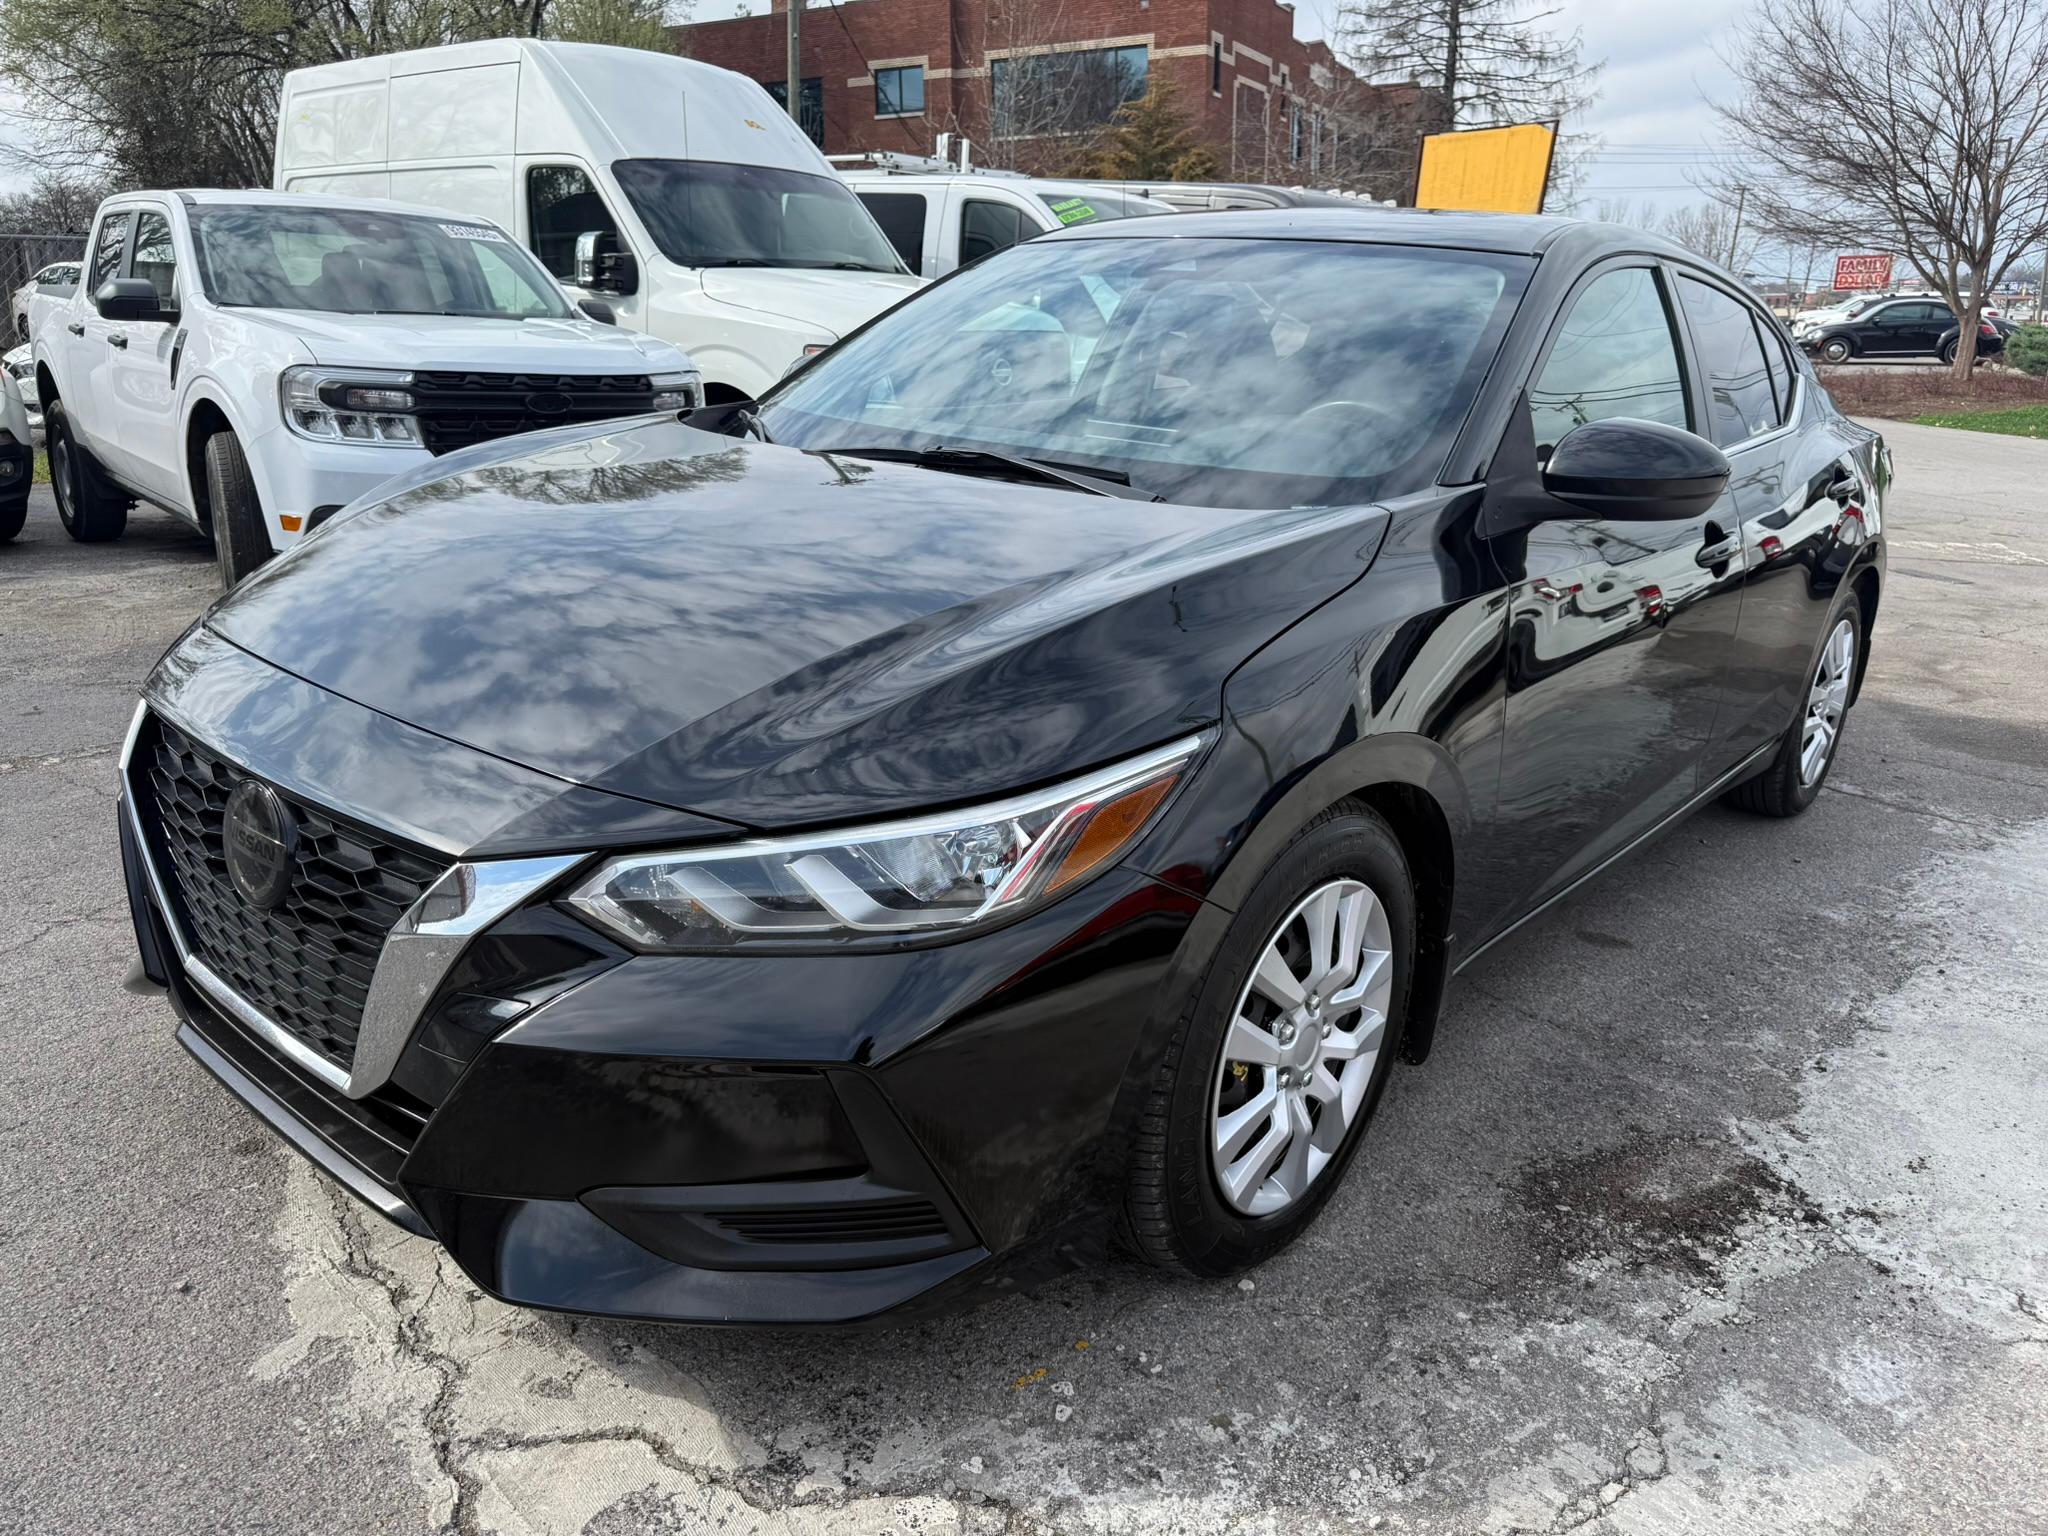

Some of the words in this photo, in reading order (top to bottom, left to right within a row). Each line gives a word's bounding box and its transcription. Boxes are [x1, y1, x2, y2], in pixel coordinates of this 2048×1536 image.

[1839, 257, 1888, 273] FAMILY
[1837, 273, 1884, 288] DOLLAR
[231, 822, 276, 863] NISSAN
